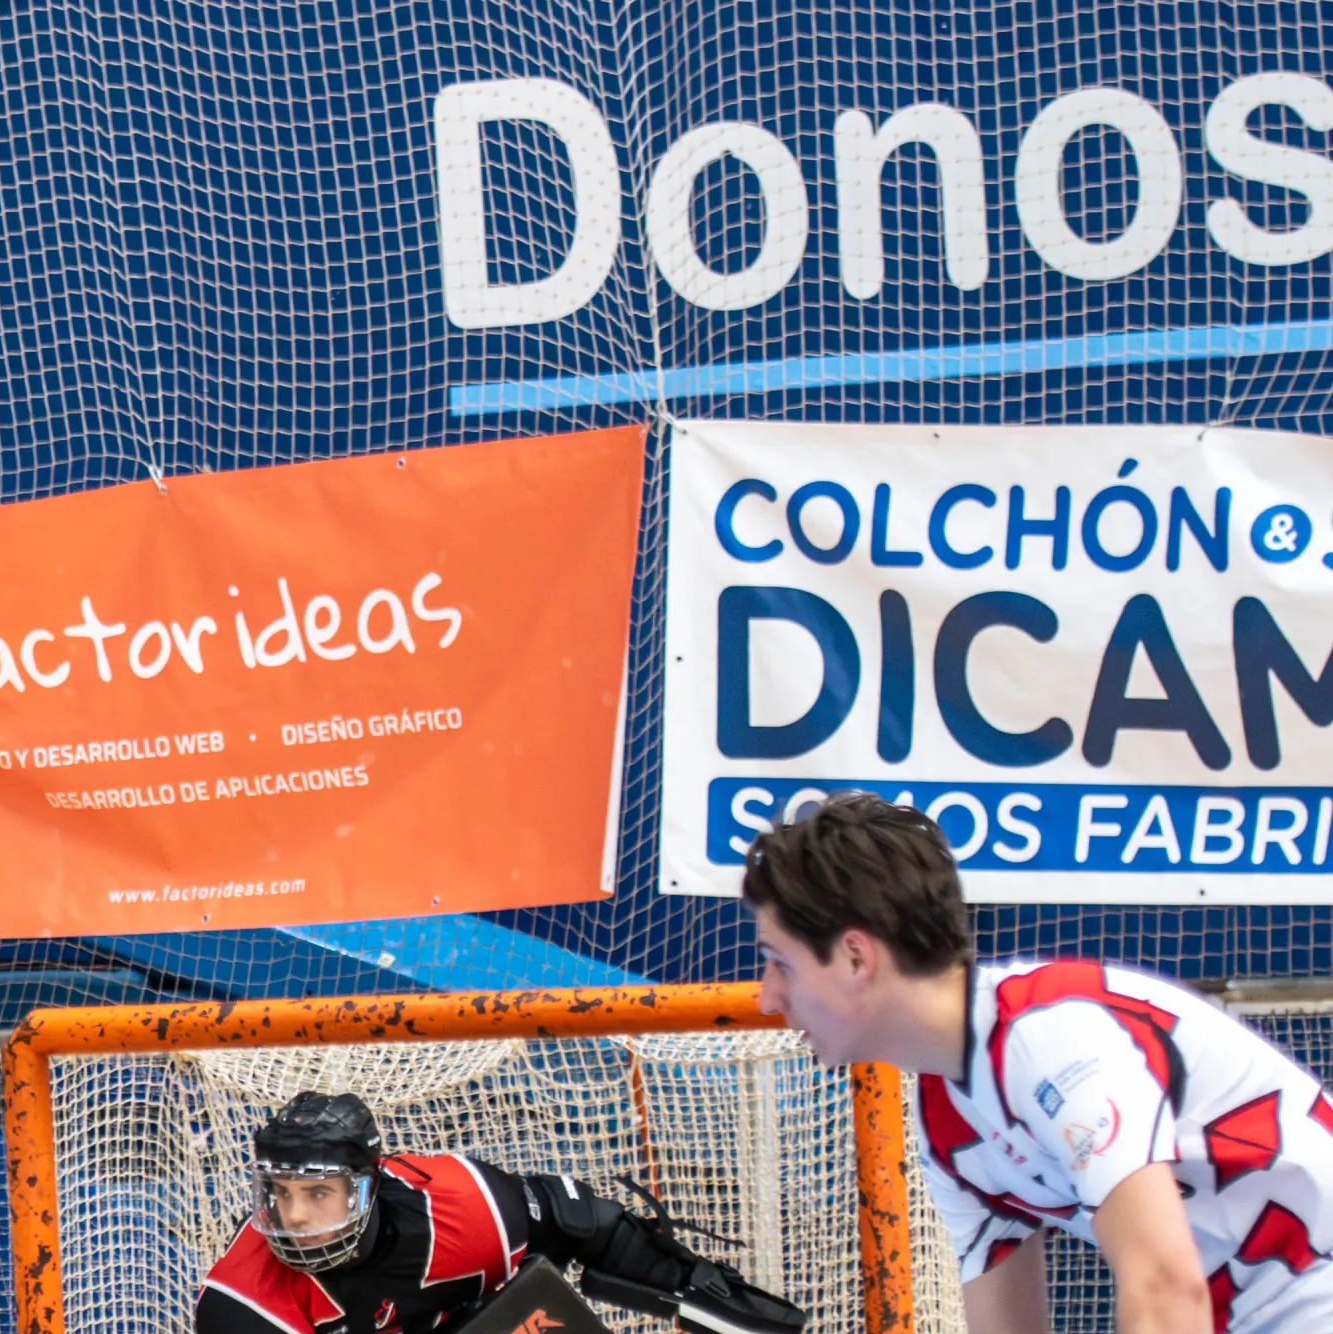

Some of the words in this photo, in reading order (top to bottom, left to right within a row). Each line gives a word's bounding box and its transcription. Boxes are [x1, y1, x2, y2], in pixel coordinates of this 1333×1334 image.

[434, 72, 1333, 329] Donos
[714, 457, 1232, 573] COLCHÓN
[14, 747, 30, 769] Y
[33, 735, 171, 769] DESARROLLO
[174, 729, 225, 756] WEB
[280, 714, 364, 746] DISEÑO
[367, 706, 463, 738] GRÁFICO
[44, 783, 176, 809] DESARROLLO
[178, 780, 211, 804] DE
[214, 765, 370, 800] APLICACIONES
[728, 786, 1043, 864] SOS
[1074, 795, 1332, 865] FABRI
[107, 877, 307, 904] www.factorideas.com
